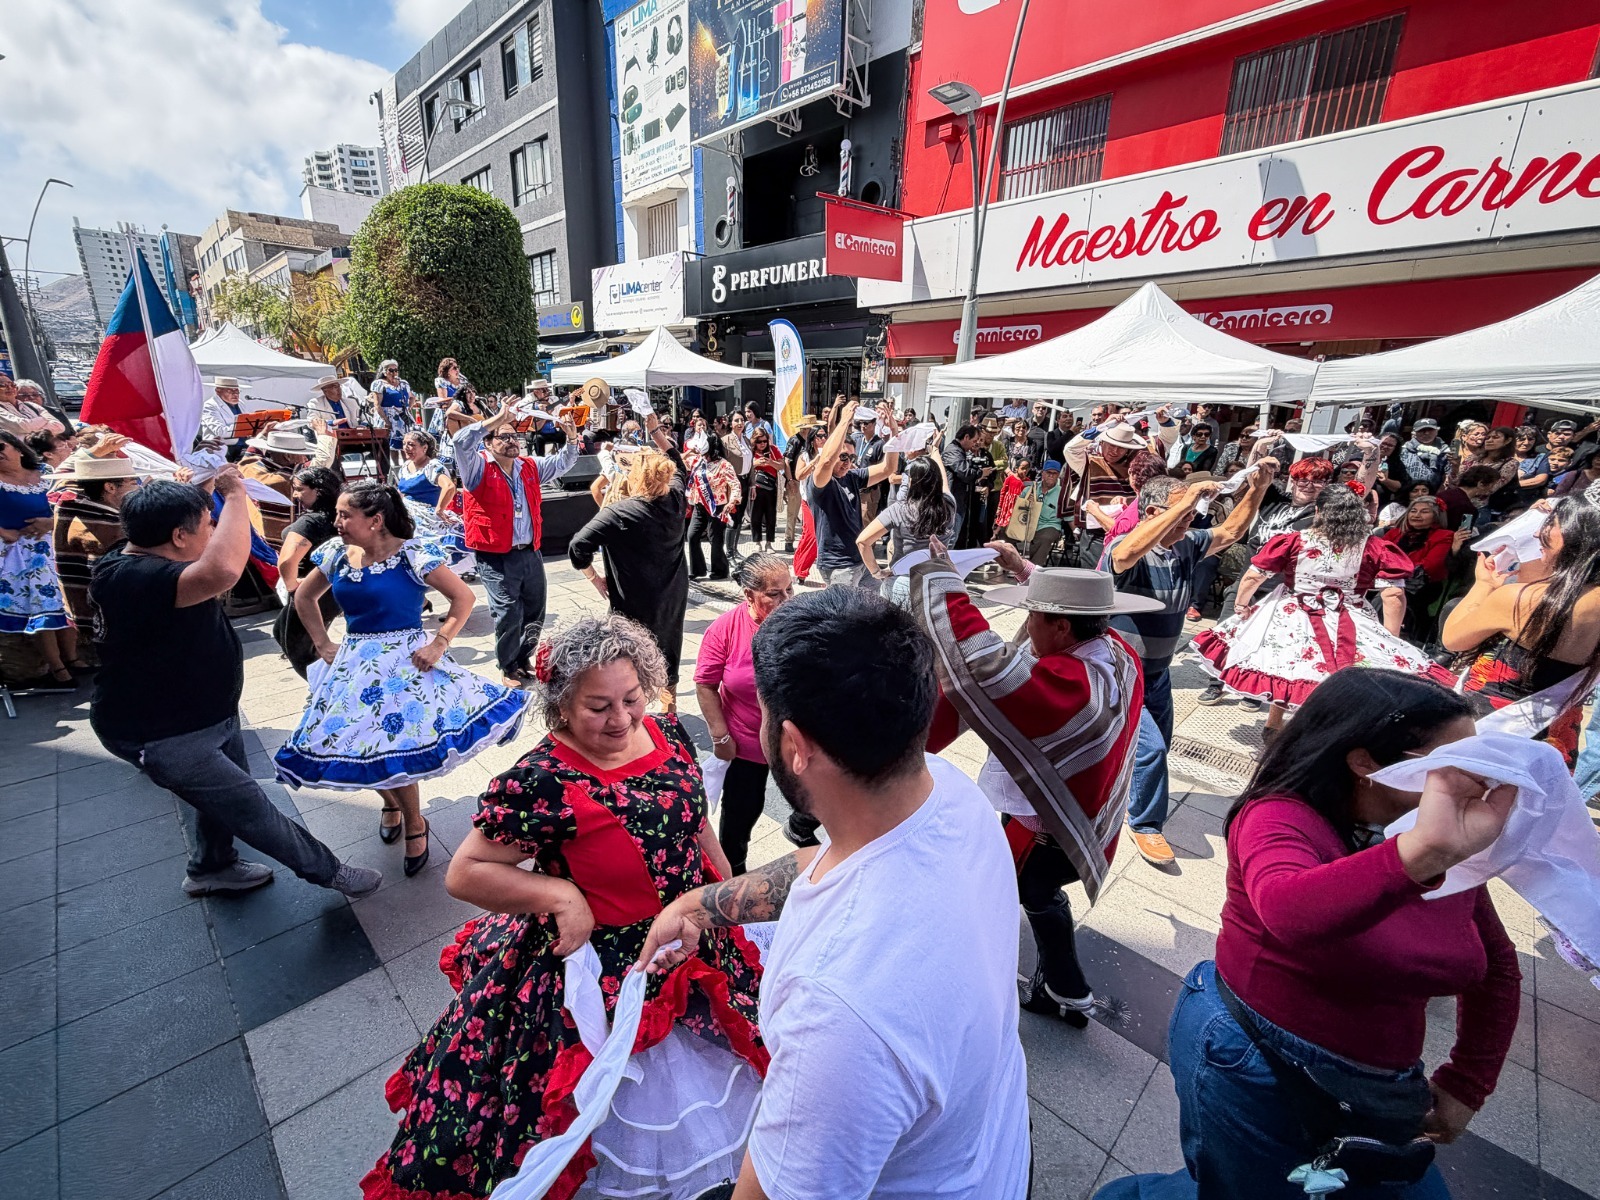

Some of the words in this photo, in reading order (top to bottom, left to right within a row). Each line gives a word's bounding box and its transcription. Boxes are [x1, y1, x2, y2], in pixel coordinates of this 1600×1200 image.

[1016, 190, 1221, 272] Maestro
[1247, 192, 1335, 241] en
[835, 232, 845, 249] El
[844, 234, 896, 257] Carnicero
[730, 257, 832, 291] PERFUMERI
[1204, 305, 1333, 330] Carnicero
[976, 325, 1042, 342] arnicero
